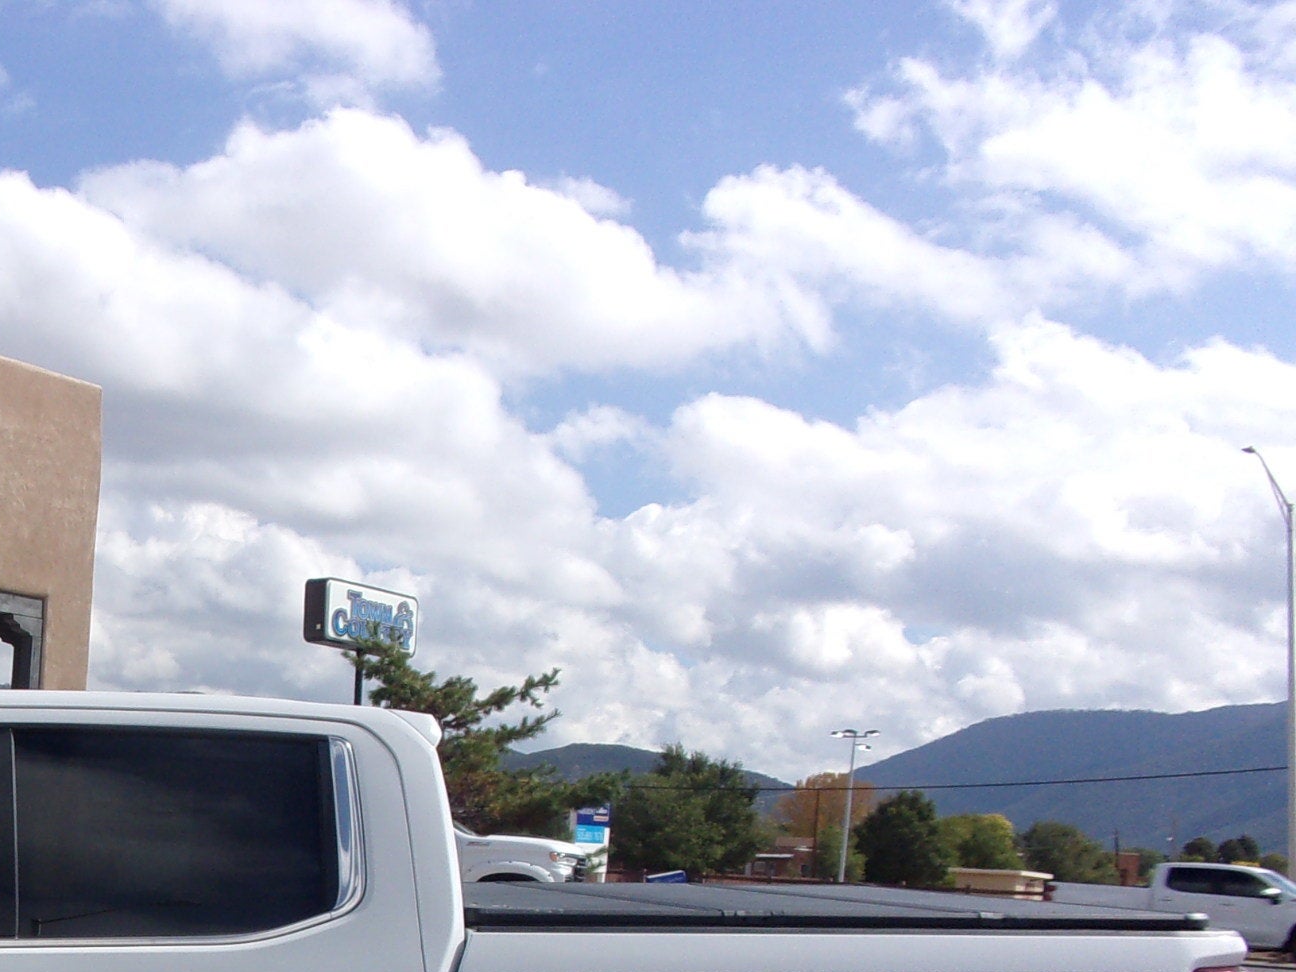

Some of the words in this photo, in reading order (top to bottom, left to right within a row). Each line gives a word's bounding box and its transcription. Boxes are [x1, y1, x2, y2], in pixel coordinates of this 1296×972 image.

[332, 607, 414, 650] COUTY
[347, 589, 393, 624] TOWN
[394, 600, 414, 630] &
